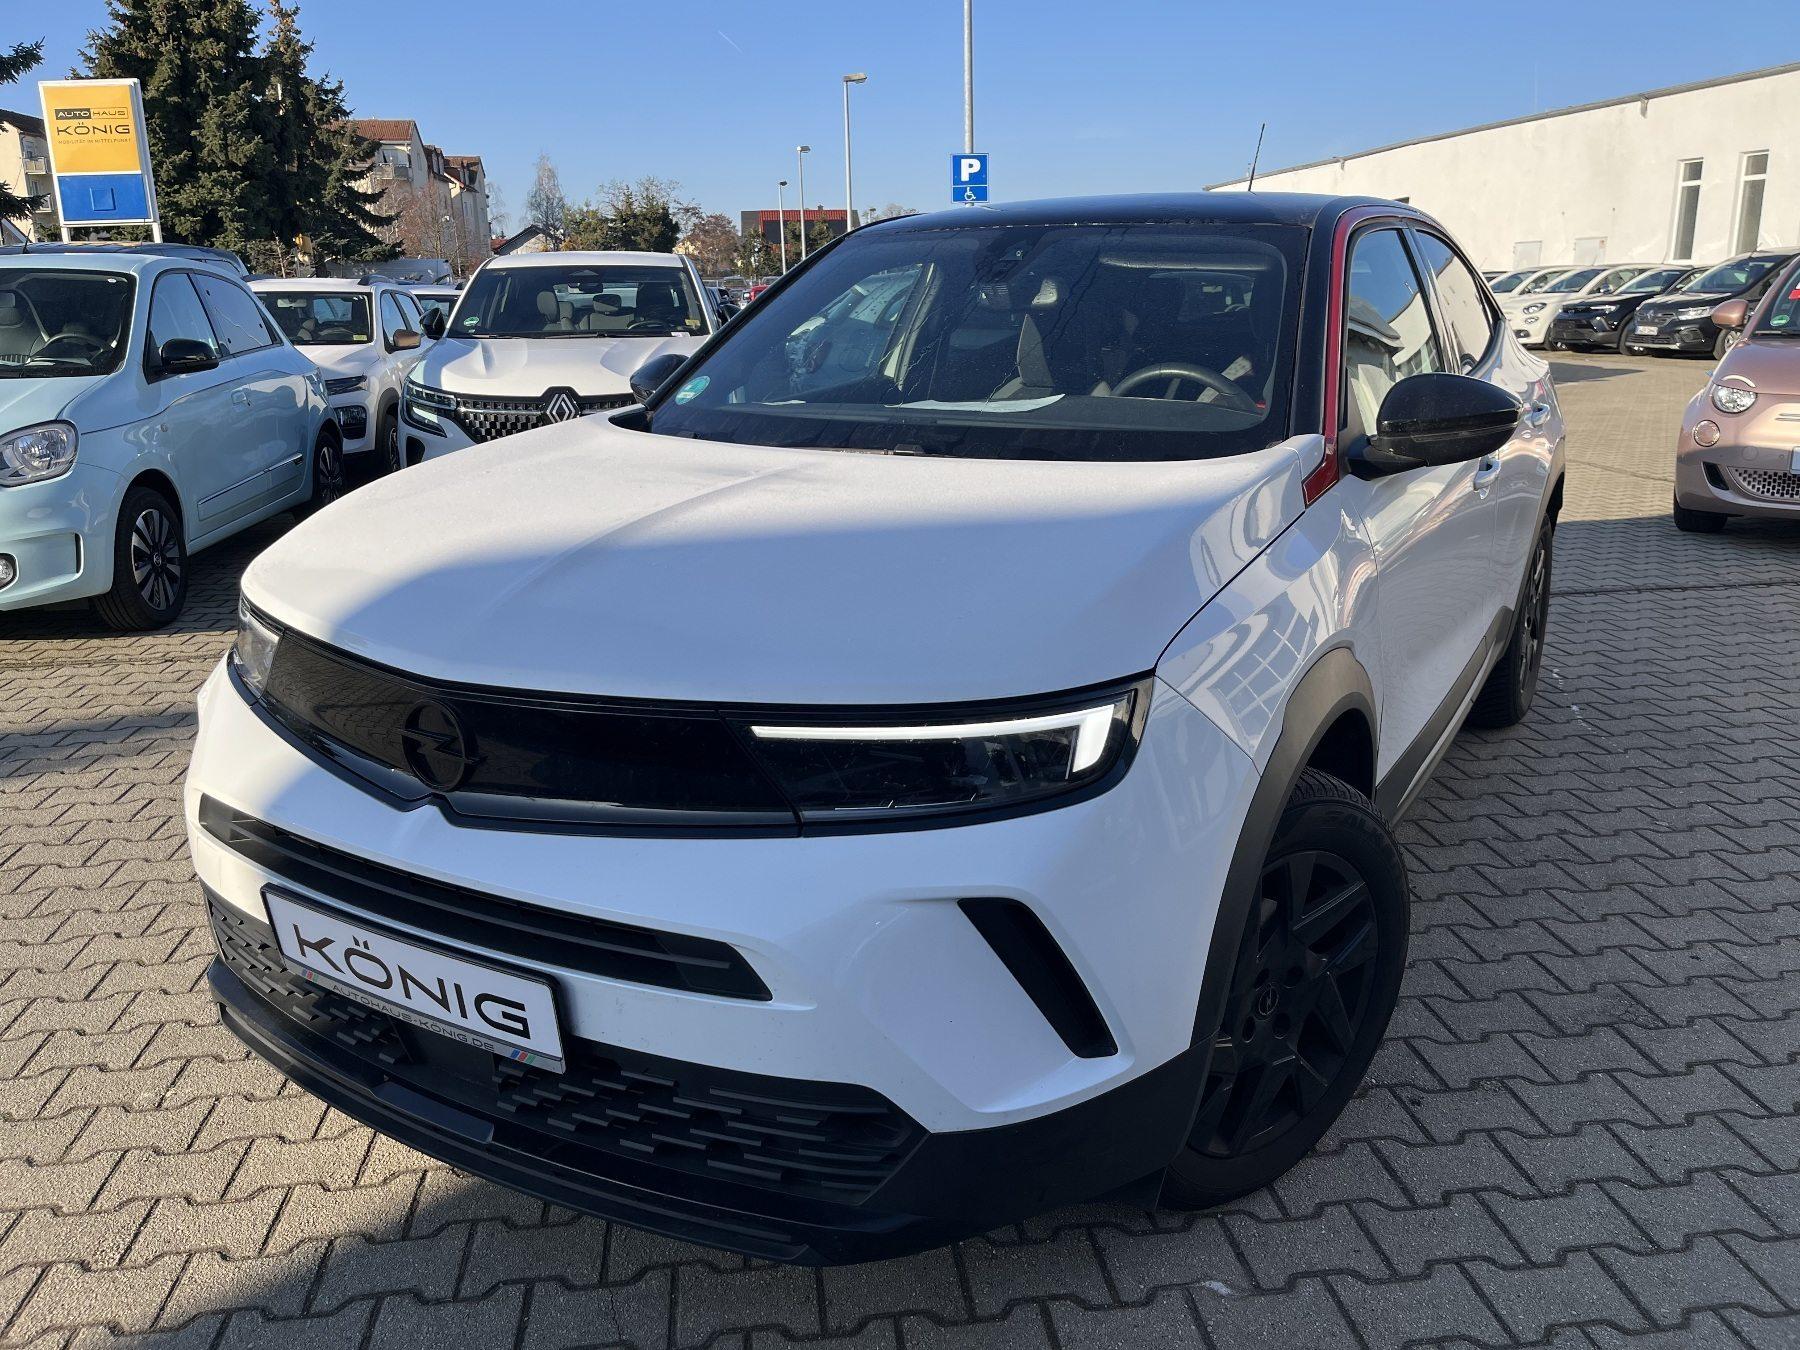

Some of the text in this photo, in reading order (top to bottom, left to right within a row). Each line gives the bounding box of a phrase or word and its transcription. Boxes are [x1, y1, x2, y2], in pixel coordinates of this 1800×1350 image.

[57, 121, 130, 135] KÖNIG
[961, 158, 981, 181] P
[293, 923, 531, 1040] KÖNIG
